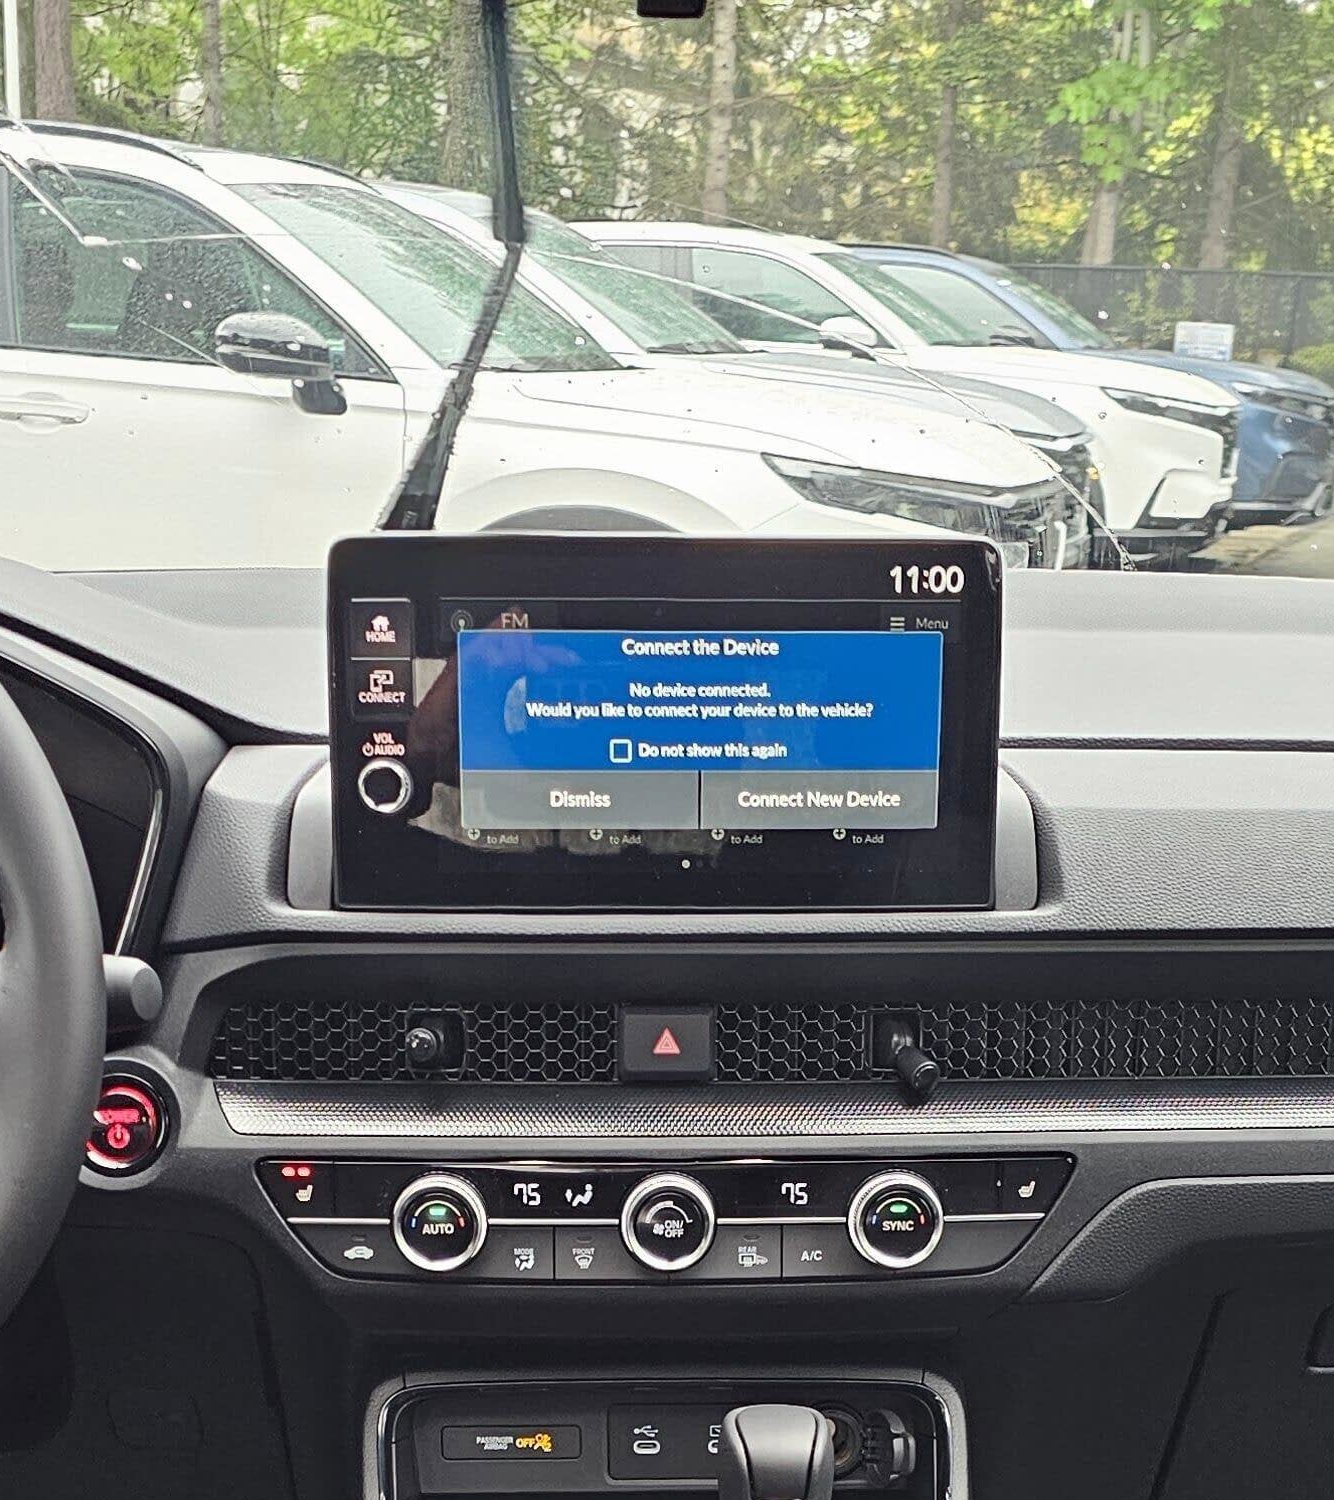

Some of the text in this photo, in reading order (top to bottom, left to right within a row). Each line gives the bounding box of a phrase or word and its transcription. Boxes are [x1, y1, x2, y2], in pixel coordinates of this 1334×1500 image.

[889, 565, 965, 594] 11:00
[501, 613, 529, 629] FM
[916, 617, 949, 629] Menu
[365, 631, 396, 643] HOME
[622, 639, 780, 656] Connect the Device
[629, 682, 771, 698] No device connected.
[359, 690, 407, 704] CONNECT
[526, 703, 874, 720] Would you like to connect your device to the vehicle?
[373, 732, 394, 744] VOL
[374, 744, 405, 757] AUDIO
[638, 743, 788, 760] Do not show this again
[549, 791, 612, 808] Dismiss
[737, 791, 901, 808] Connect New Device
[487, 834, 519, 845] to Add
[609, 834, 641, 845] to Add
[730, 834, 763, 845] to Add
[852, 834, 884, 845] to Add
[513, 1183, 541, 1206] 75
[781, 1182, 808, 1205] 75
[422, 1223, 454, 1236] AUTO
[665, 1220, 684, 1229] ON/
[882, 1220, 914, 1232] SYNC
[664, 1228, 684, 1238] OFF
[571, 1247, 595, 1255] FRONT
[800, 1250, 822, 1261] A/C
[516, 1437, 535, 1448] OFF
